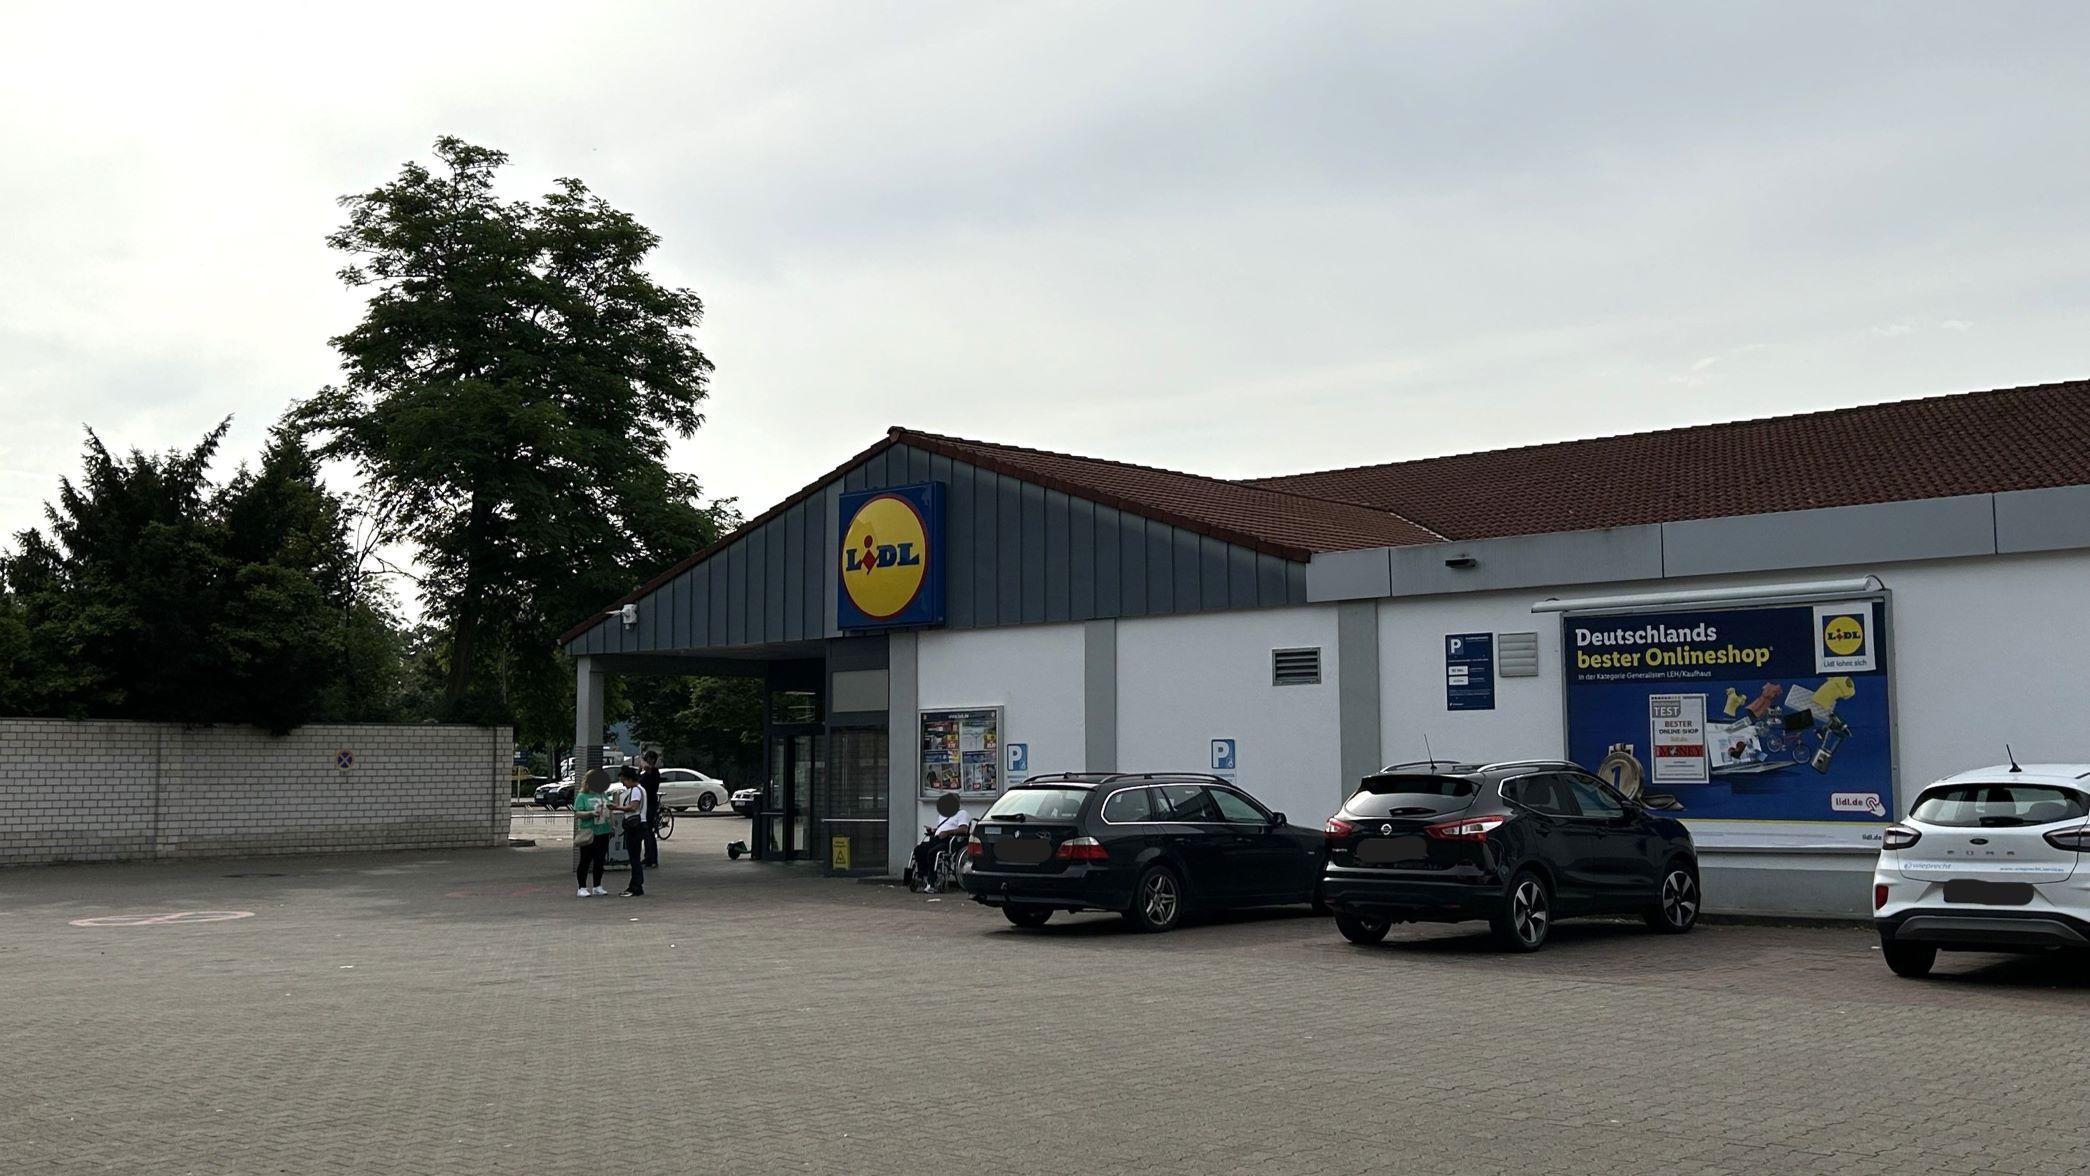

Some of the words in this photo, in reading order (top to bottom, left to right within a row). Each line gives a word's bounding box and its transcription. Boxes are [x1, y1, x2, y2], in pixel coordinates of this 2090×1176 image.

[1576, 623, 1717, 646] Deutschlands
[1450, 638, 1462, 654] P
[1577, 650, 1641, 668] bester
[1596, 673, 1625, 681] Kategorie
[1626, 671, 1666, 680] Generalisten
[1654, 706, 1680, 716] TEST
[1664, 720, 1693, 728] BESTER
[1836, 797, 1864, 806] lidl.de
